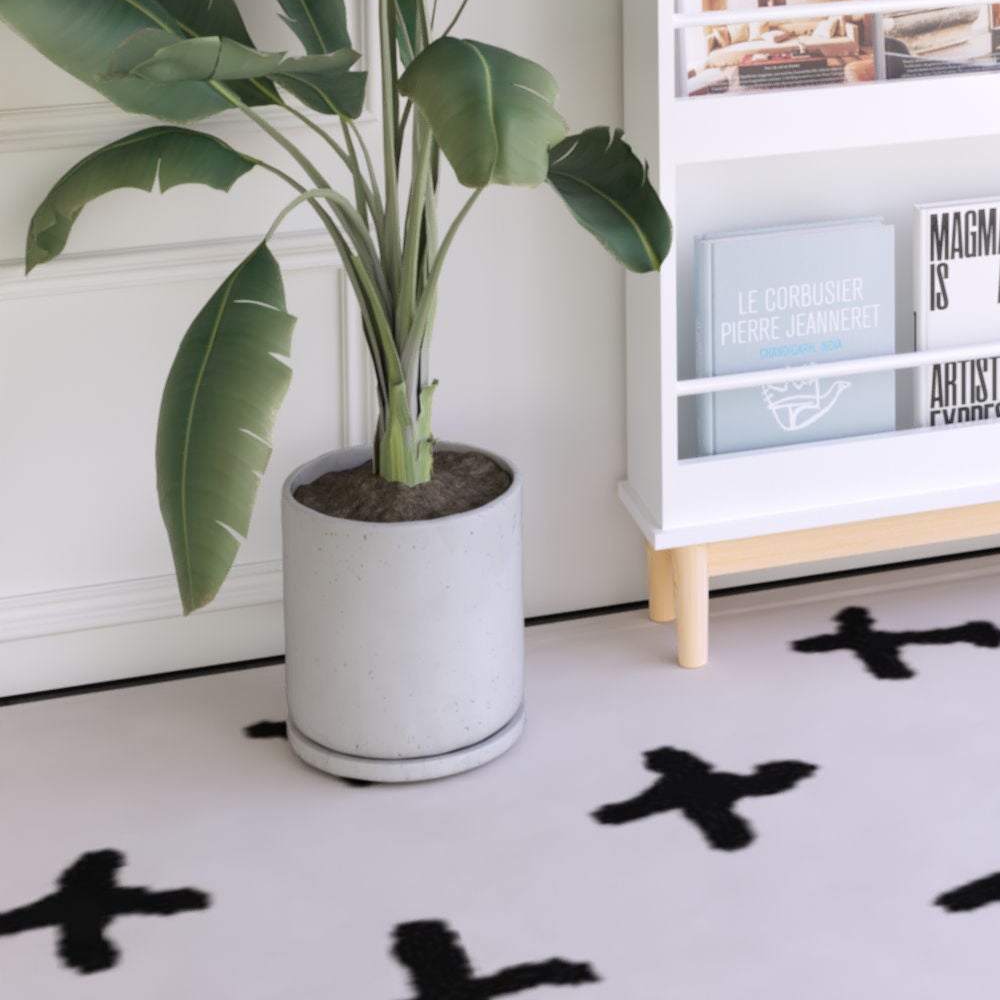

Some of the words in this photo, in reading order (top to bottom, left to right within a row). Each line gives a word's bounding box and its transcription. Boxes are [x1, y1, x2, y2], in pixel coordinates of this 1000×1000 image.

[738, 289, 758, 316] LE
[765, 277, 864, 313] CORBUSIER
[930, 262, 949, 311] IS
[721, 316, 781, 346] PIERRE
[785, 304, 880, 339] JEANNERET
